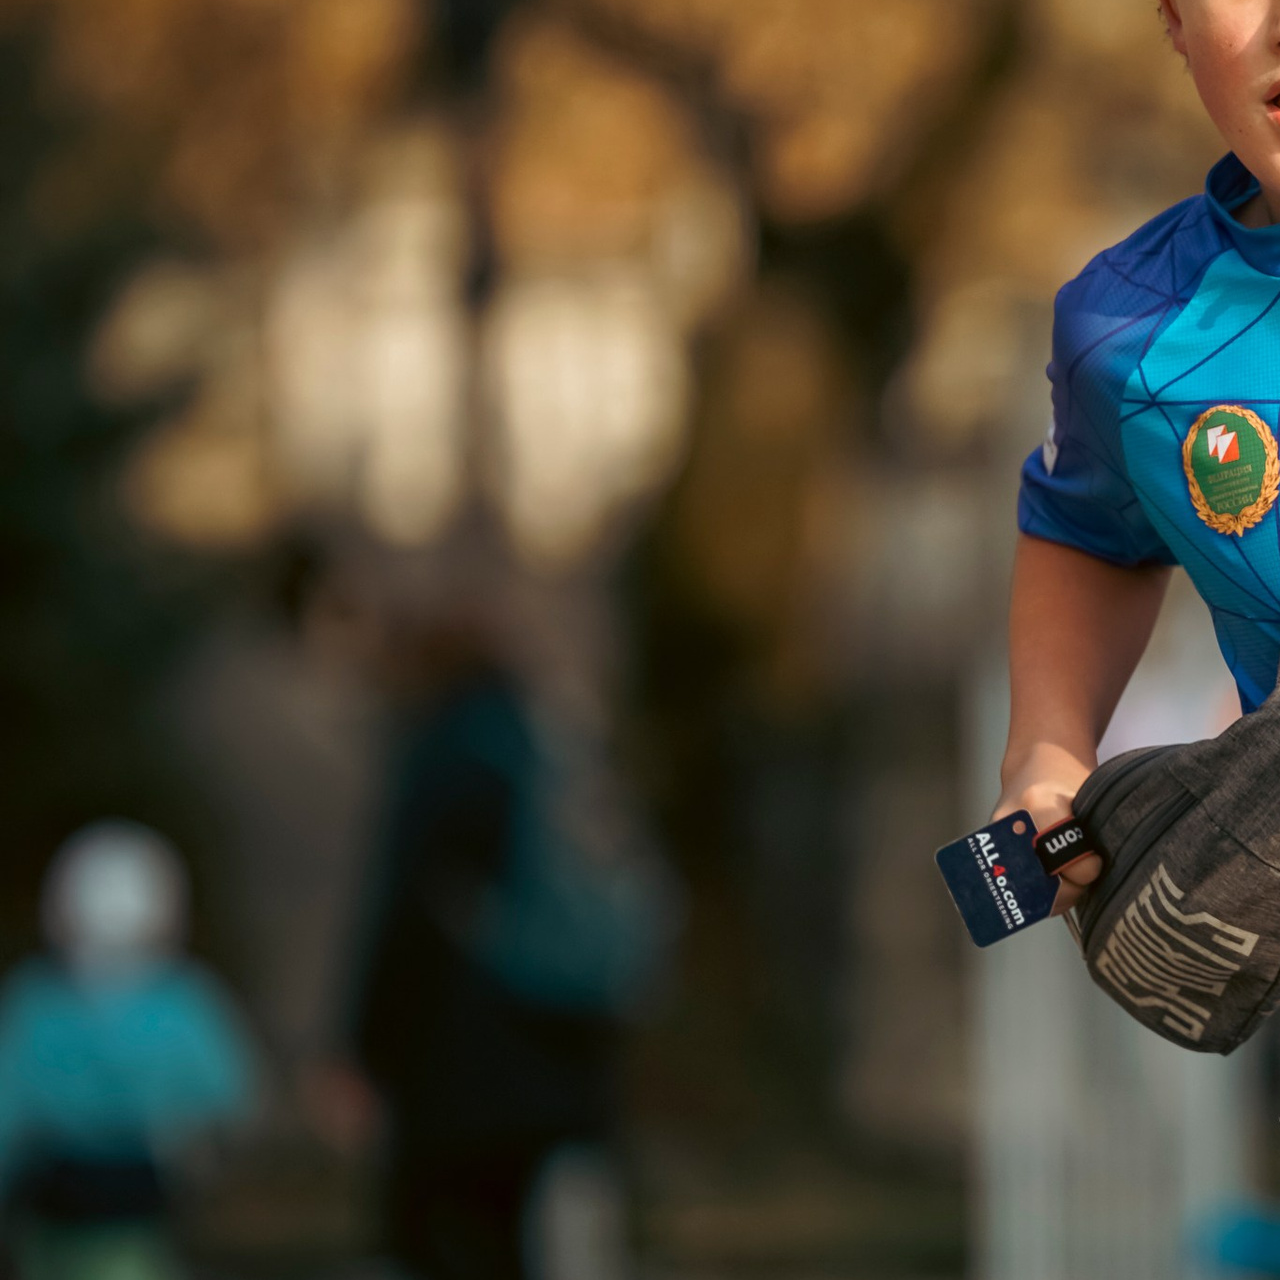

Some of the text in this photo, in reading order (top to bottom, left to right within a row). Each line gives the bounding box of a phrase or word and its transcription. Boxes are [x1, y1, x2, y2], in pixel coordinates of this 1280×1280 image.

[967, 837, 1014, 930] ALL FOR ORIENTEERING
[975, 832, 1025, 925] ALL4o.com
[1096, 862, 1260, 1041] SPORTS
